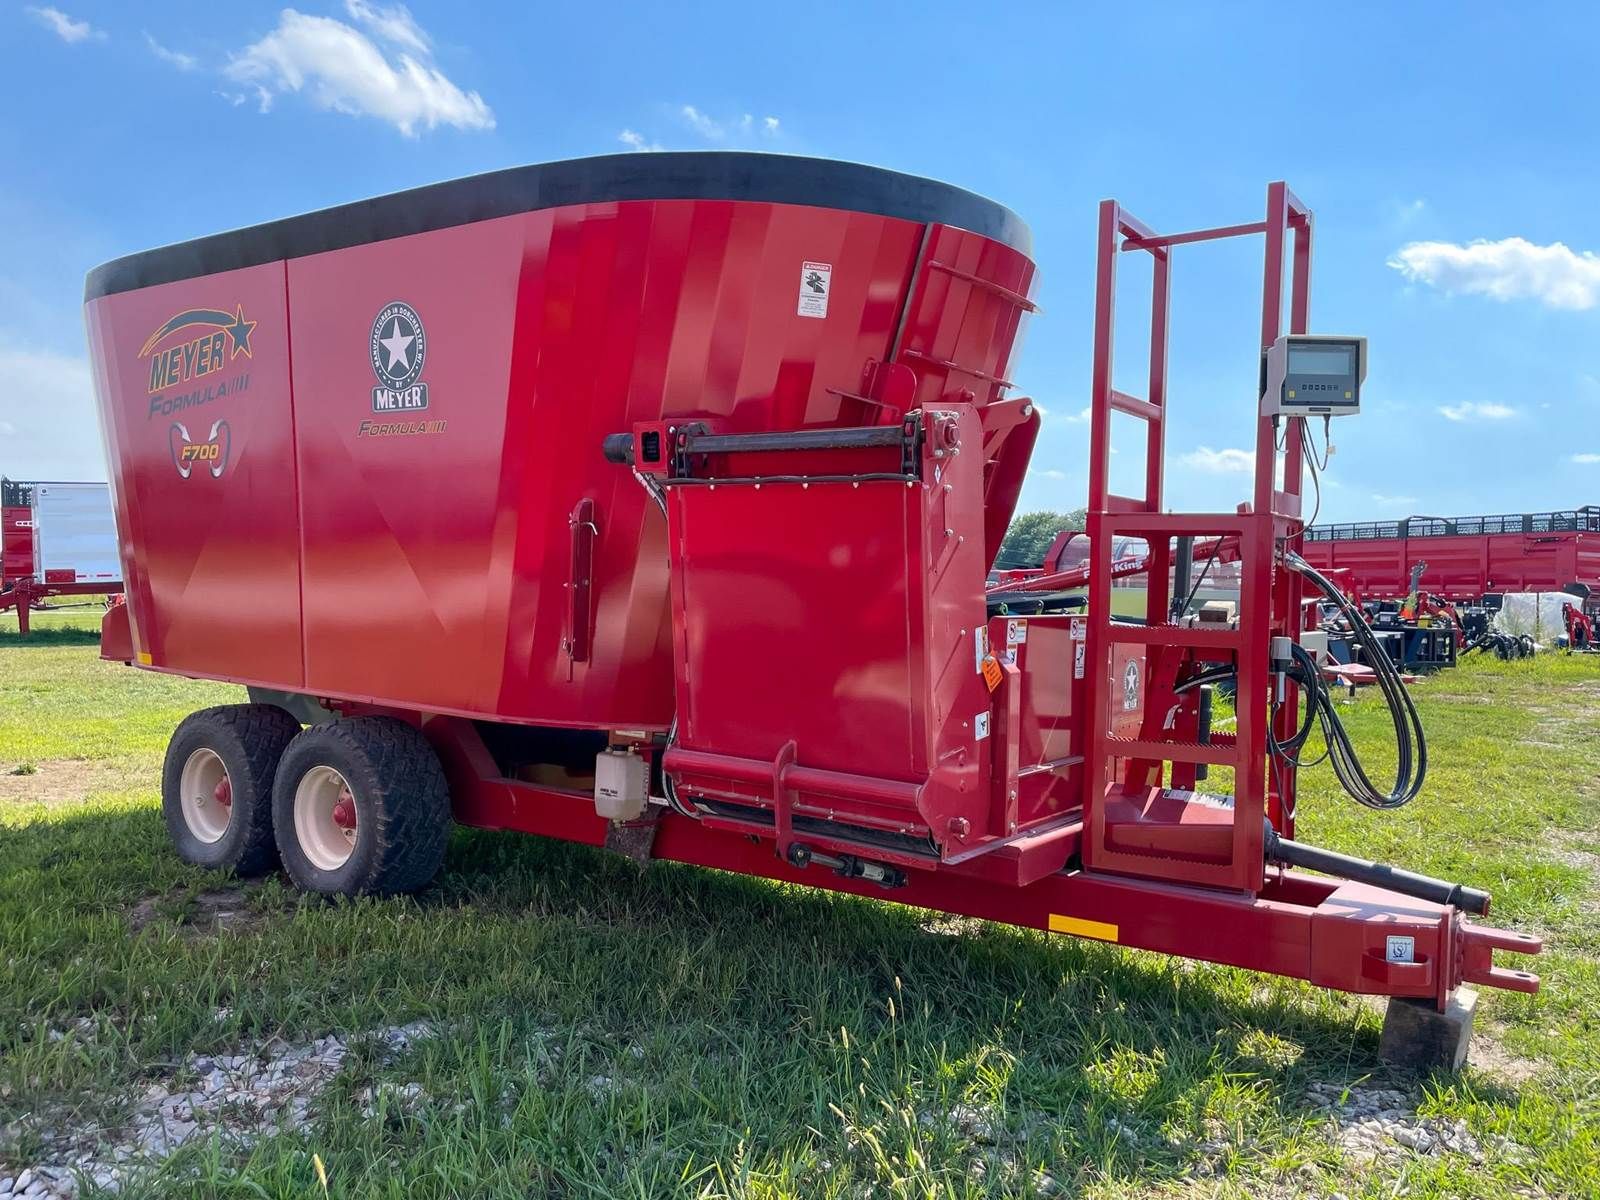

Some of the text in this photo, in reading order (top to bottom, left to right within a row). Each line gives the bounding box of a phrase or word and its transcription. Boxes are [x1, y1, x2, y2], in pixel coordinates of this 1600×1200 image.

[372, 309, 392, 368] MANUFACTURED
[399, 307, 424, 350] DORCHESTER
[147, 330, 227, 394] MEYER
[376, 386, 422, 410] MEYER
[181, 443, 219, 461] F700
[1114, 559, 1144, 573] King
